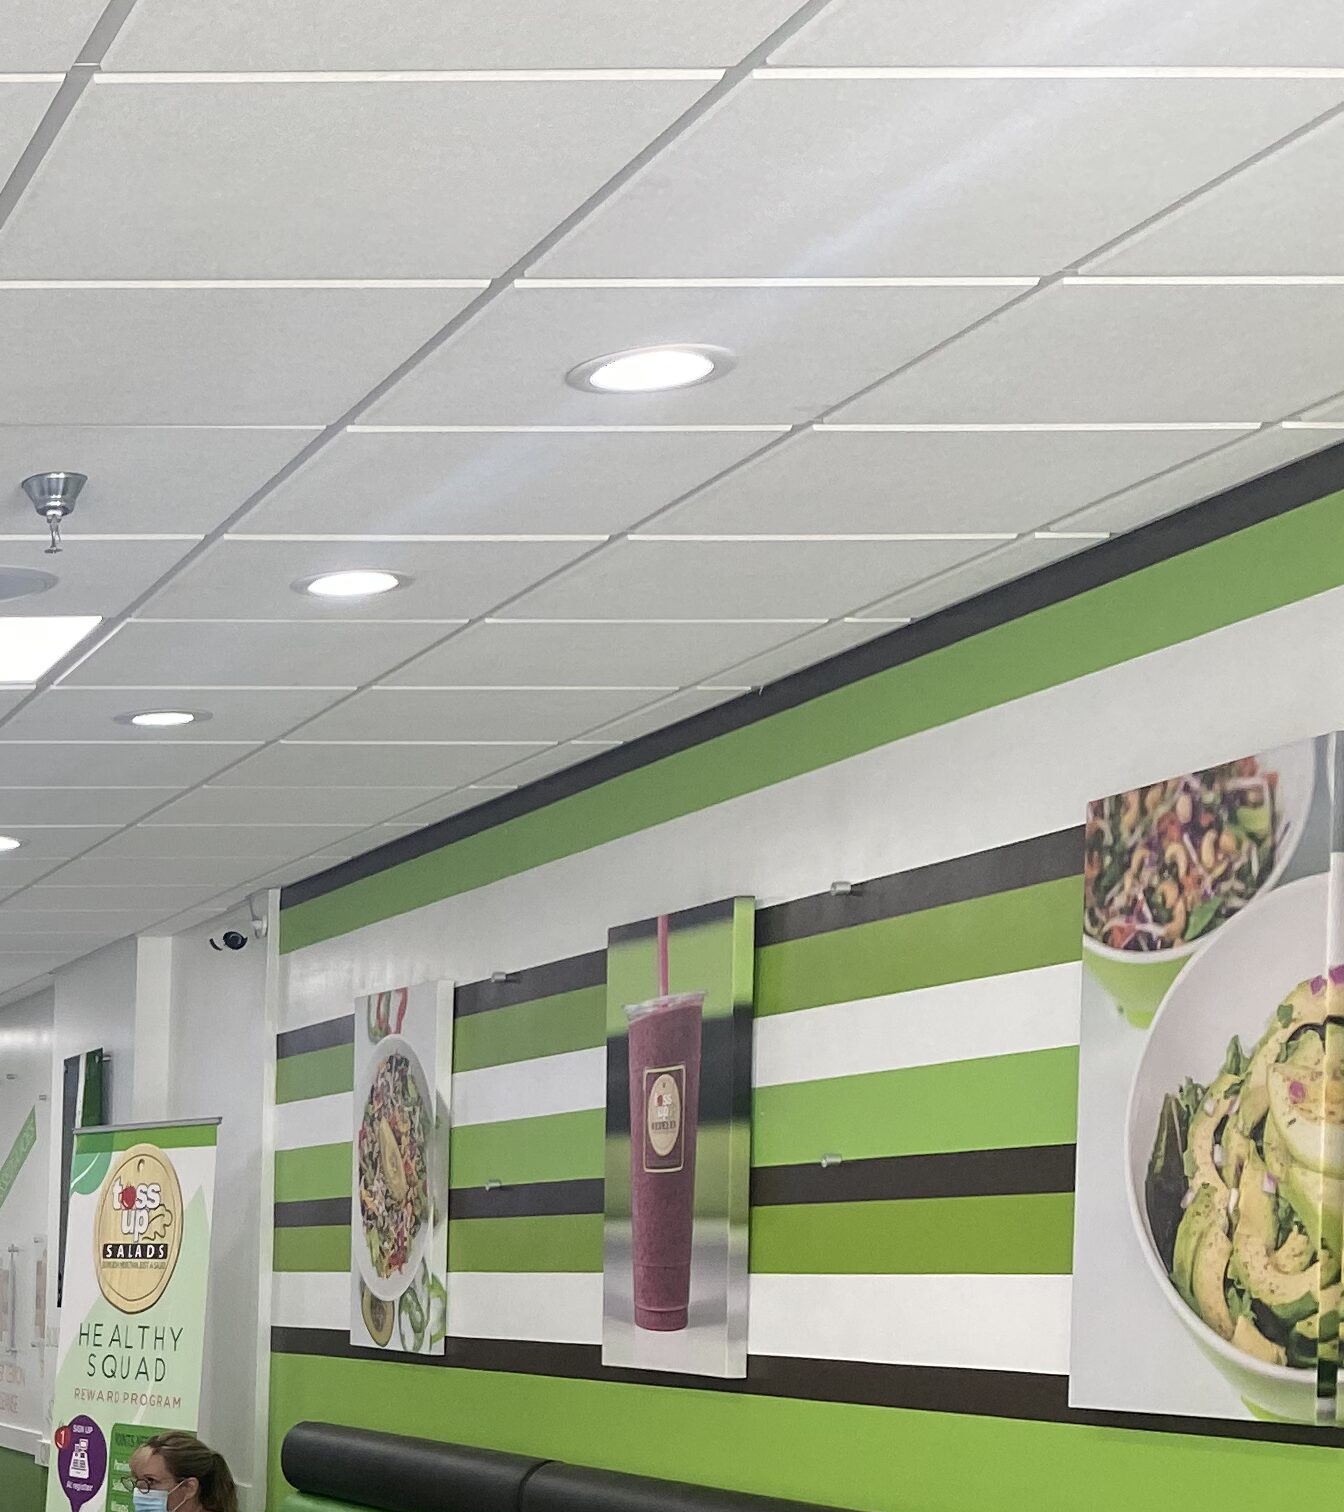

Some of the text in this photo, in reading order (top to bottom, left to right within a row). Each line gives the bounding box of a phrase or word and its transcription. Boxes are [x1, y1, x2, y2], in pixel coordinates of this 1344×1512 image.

[121, 1208, 149, 1243] up
[105, 1244, 165, 1259] SALADS
[78, 1322, 184, 1352] HEALTHY
[87, 1352, 166, 1382] SQUAD
[74, 1387, 182, 1409] REWARD PROGRAM
[60, 1430, 65, 1445] 1
